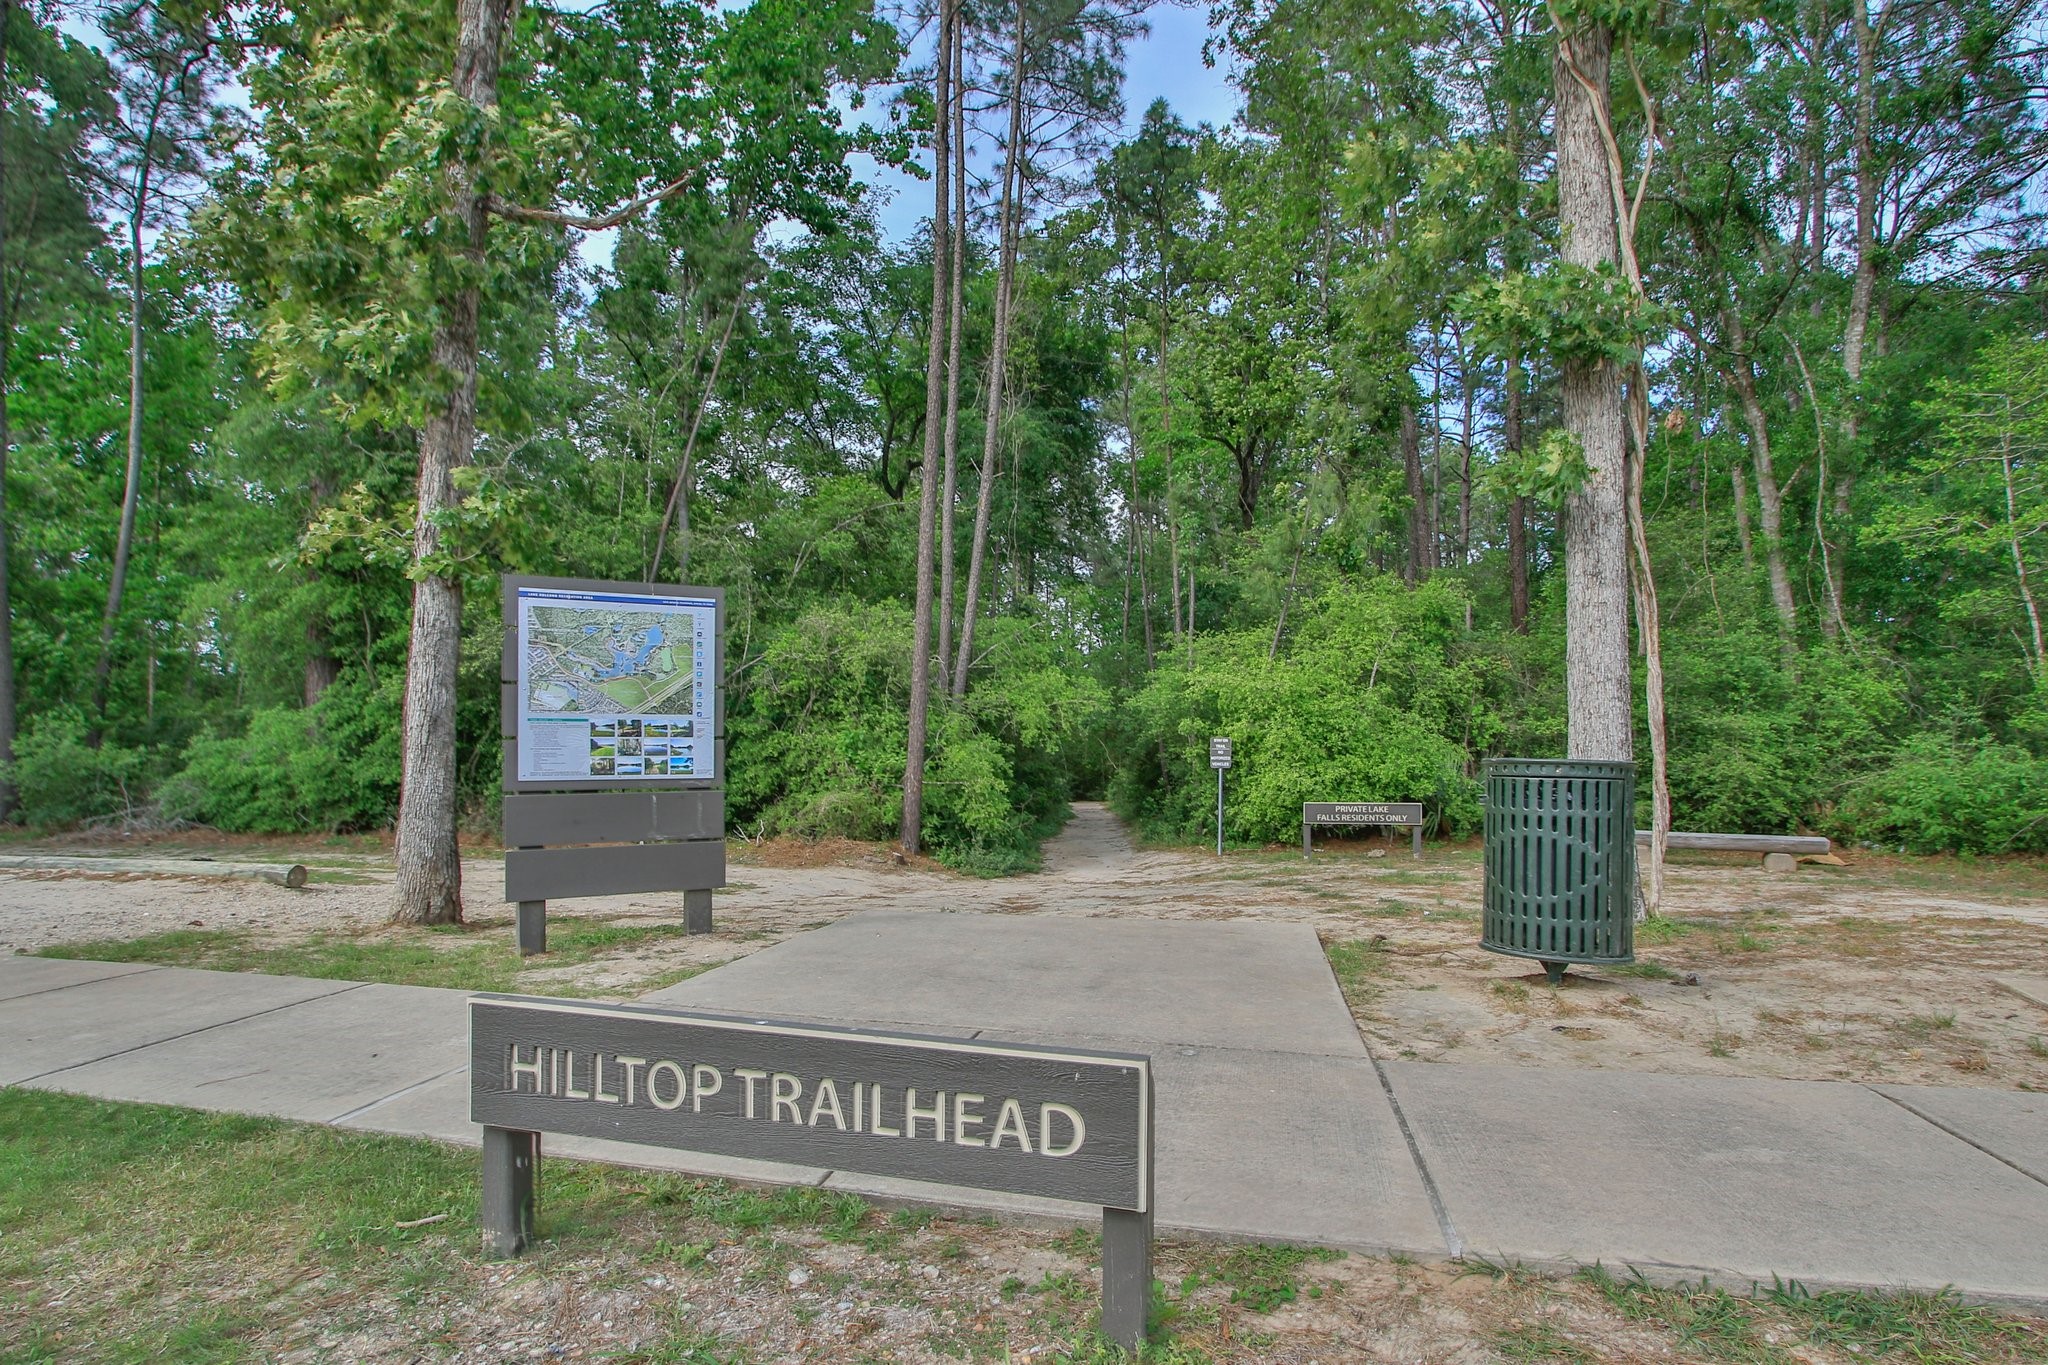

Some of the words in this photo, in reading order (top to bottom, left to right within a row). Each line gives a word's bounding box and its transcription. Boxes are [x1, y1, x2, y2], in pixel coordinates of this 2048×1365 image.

[1335, 805, 1367, 813] PRIVATE
[1368, 805, 1389, 813] LAKE
[1316, 813, 1340, 821] FALLS
[1341, 814, 1385, 822] RESIDENTS
[1385, 814, 1408, 822] ONLY
[509, 1043, 723, 1113] HILLTOP
[733, 1067, 1087, 1158] TRAILHEAD
